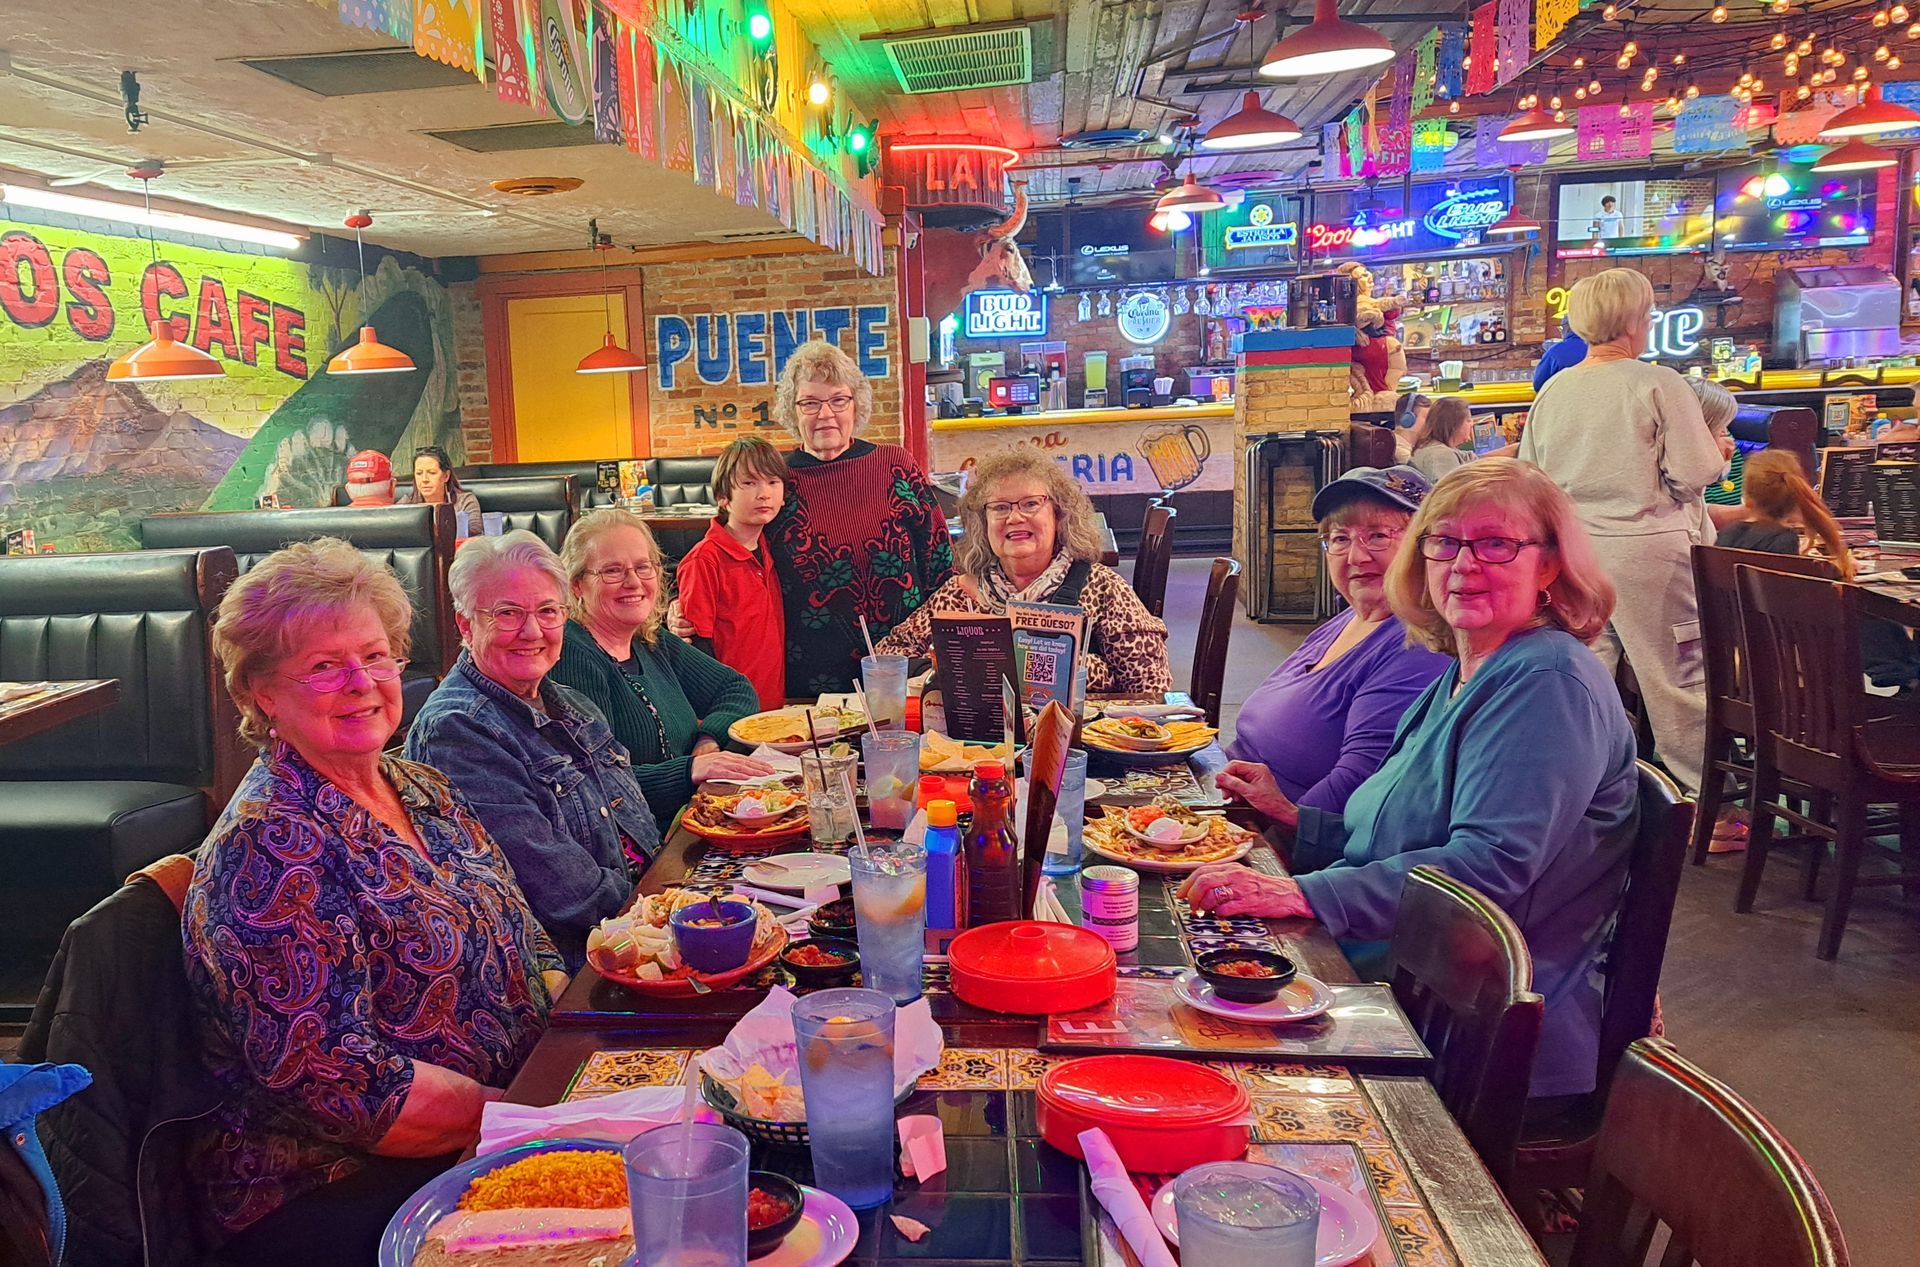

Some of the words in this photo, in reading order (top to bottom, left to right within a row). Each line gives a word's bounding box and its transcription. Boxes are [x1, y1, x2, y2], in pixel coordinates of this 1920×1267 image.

[547, 16, 575, 105] Corona
[926, 152, 978, 191] LA
[1446, 201, 1503, 216] BUD
[1782, 198, 1822, 207] LEXUS
[1435, 211, 1508, 229] LIGHT
[1236, 227, 1286, 238] ESTRELLA
[1240, 234, 1281, 243] JALISCO
[1378, 220, 1416, 239] GHT
[1094, 244, 1129, 253] LEXUS
[980, 294, 1032, 314] BUD
[140, 260, 309, 380] CAFE
[970, 310, 1041, 333] LIGHT
[655, 304, 890, 391] PUENTE
[956, 626, 984, 638] LIQUOR
[1015, 616, 1038, 627] FREE
[1040, 618, 1075, 631] QUESO?
